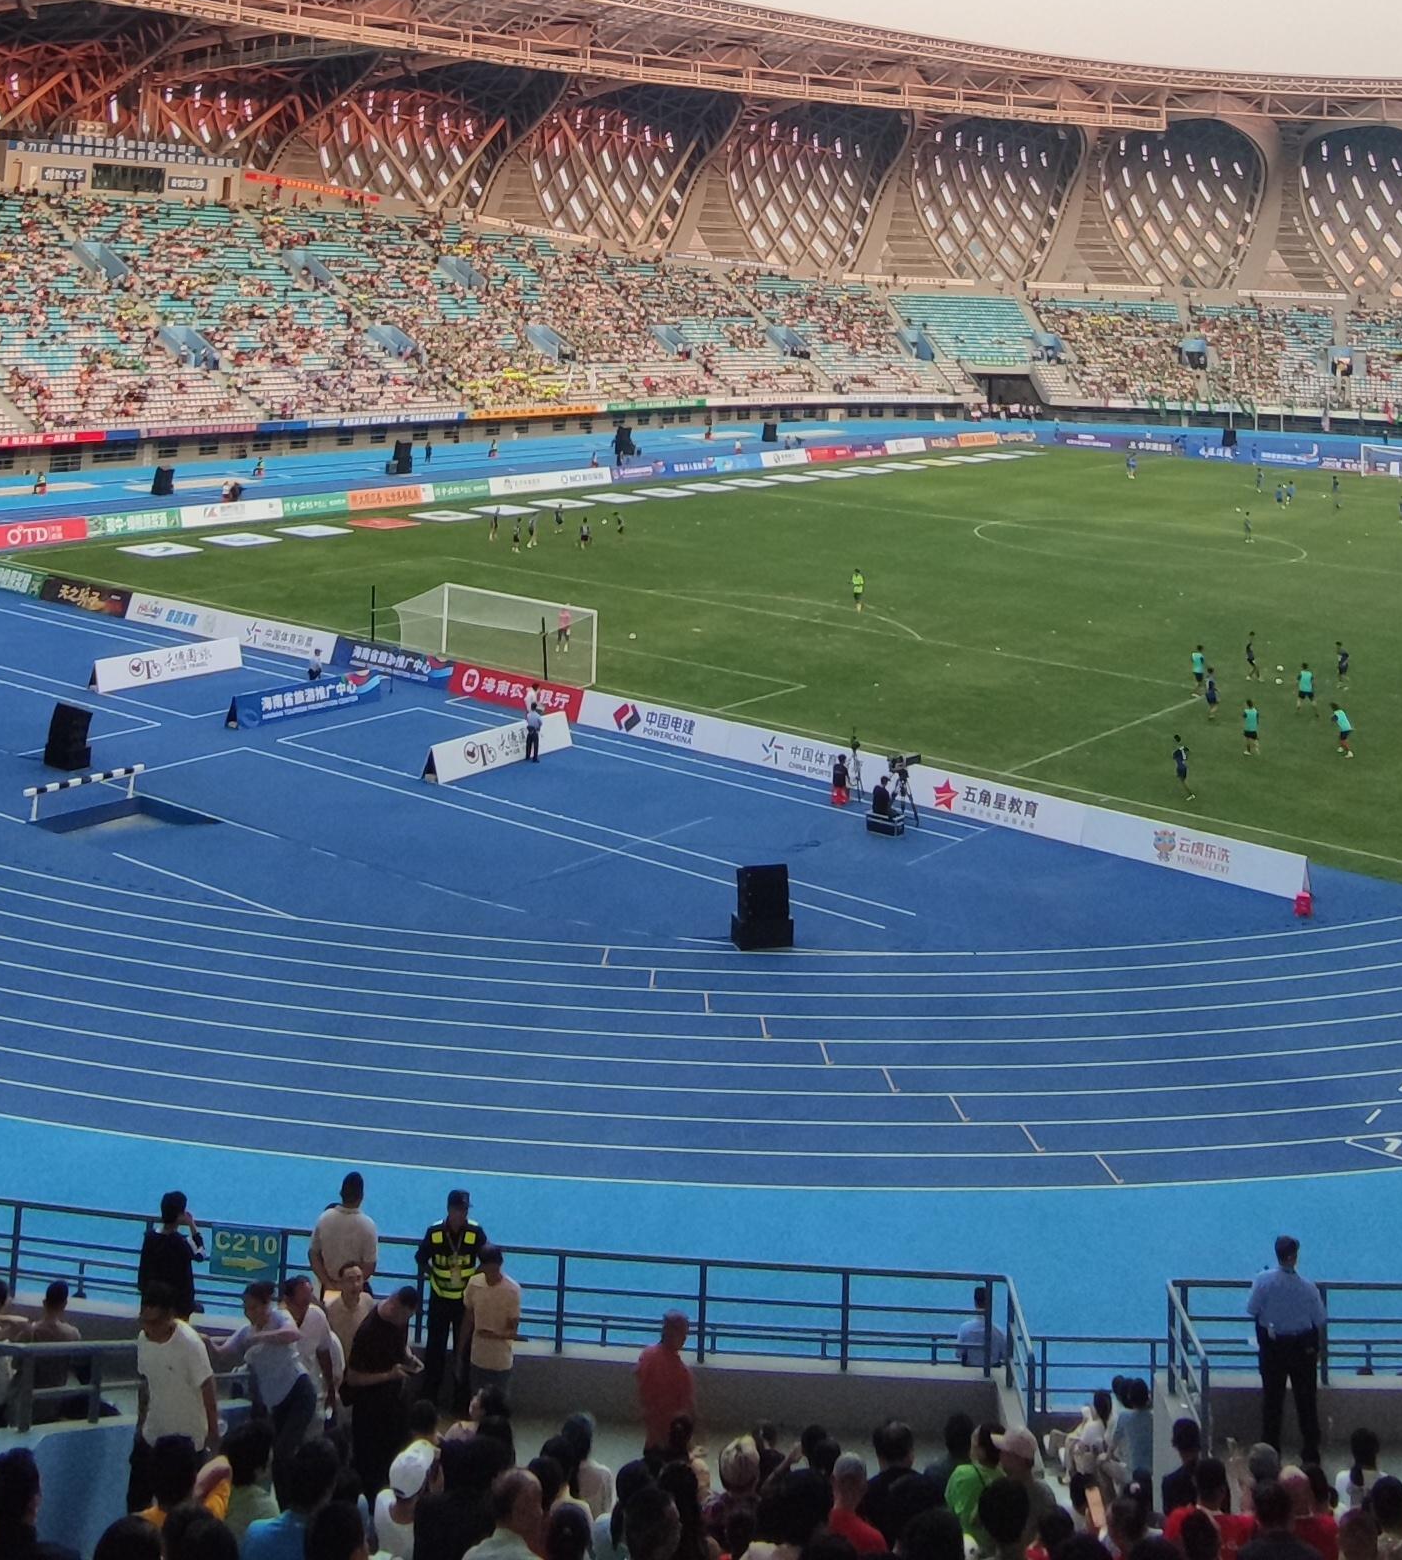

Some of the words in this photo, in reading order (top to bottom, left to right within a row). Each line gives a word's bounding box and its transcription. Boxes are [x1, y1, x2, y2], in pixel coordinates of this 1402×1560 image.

[264, 628, 314, 648] 中国体育彩票
[481, 676, 571, 709] 海南农银行
[645, 711, 696, 737] 中国电建
[642, 727, 693, 746] POWERCHINA
[788, 761, 807, 772] CHINA
[807, 765, 832, 778] SPORTS
[963, 785, 1039, 819] 五角星教育
[1383, 1136, 1402, 1154] 1
[215, 1231, 278, 1255] C210
